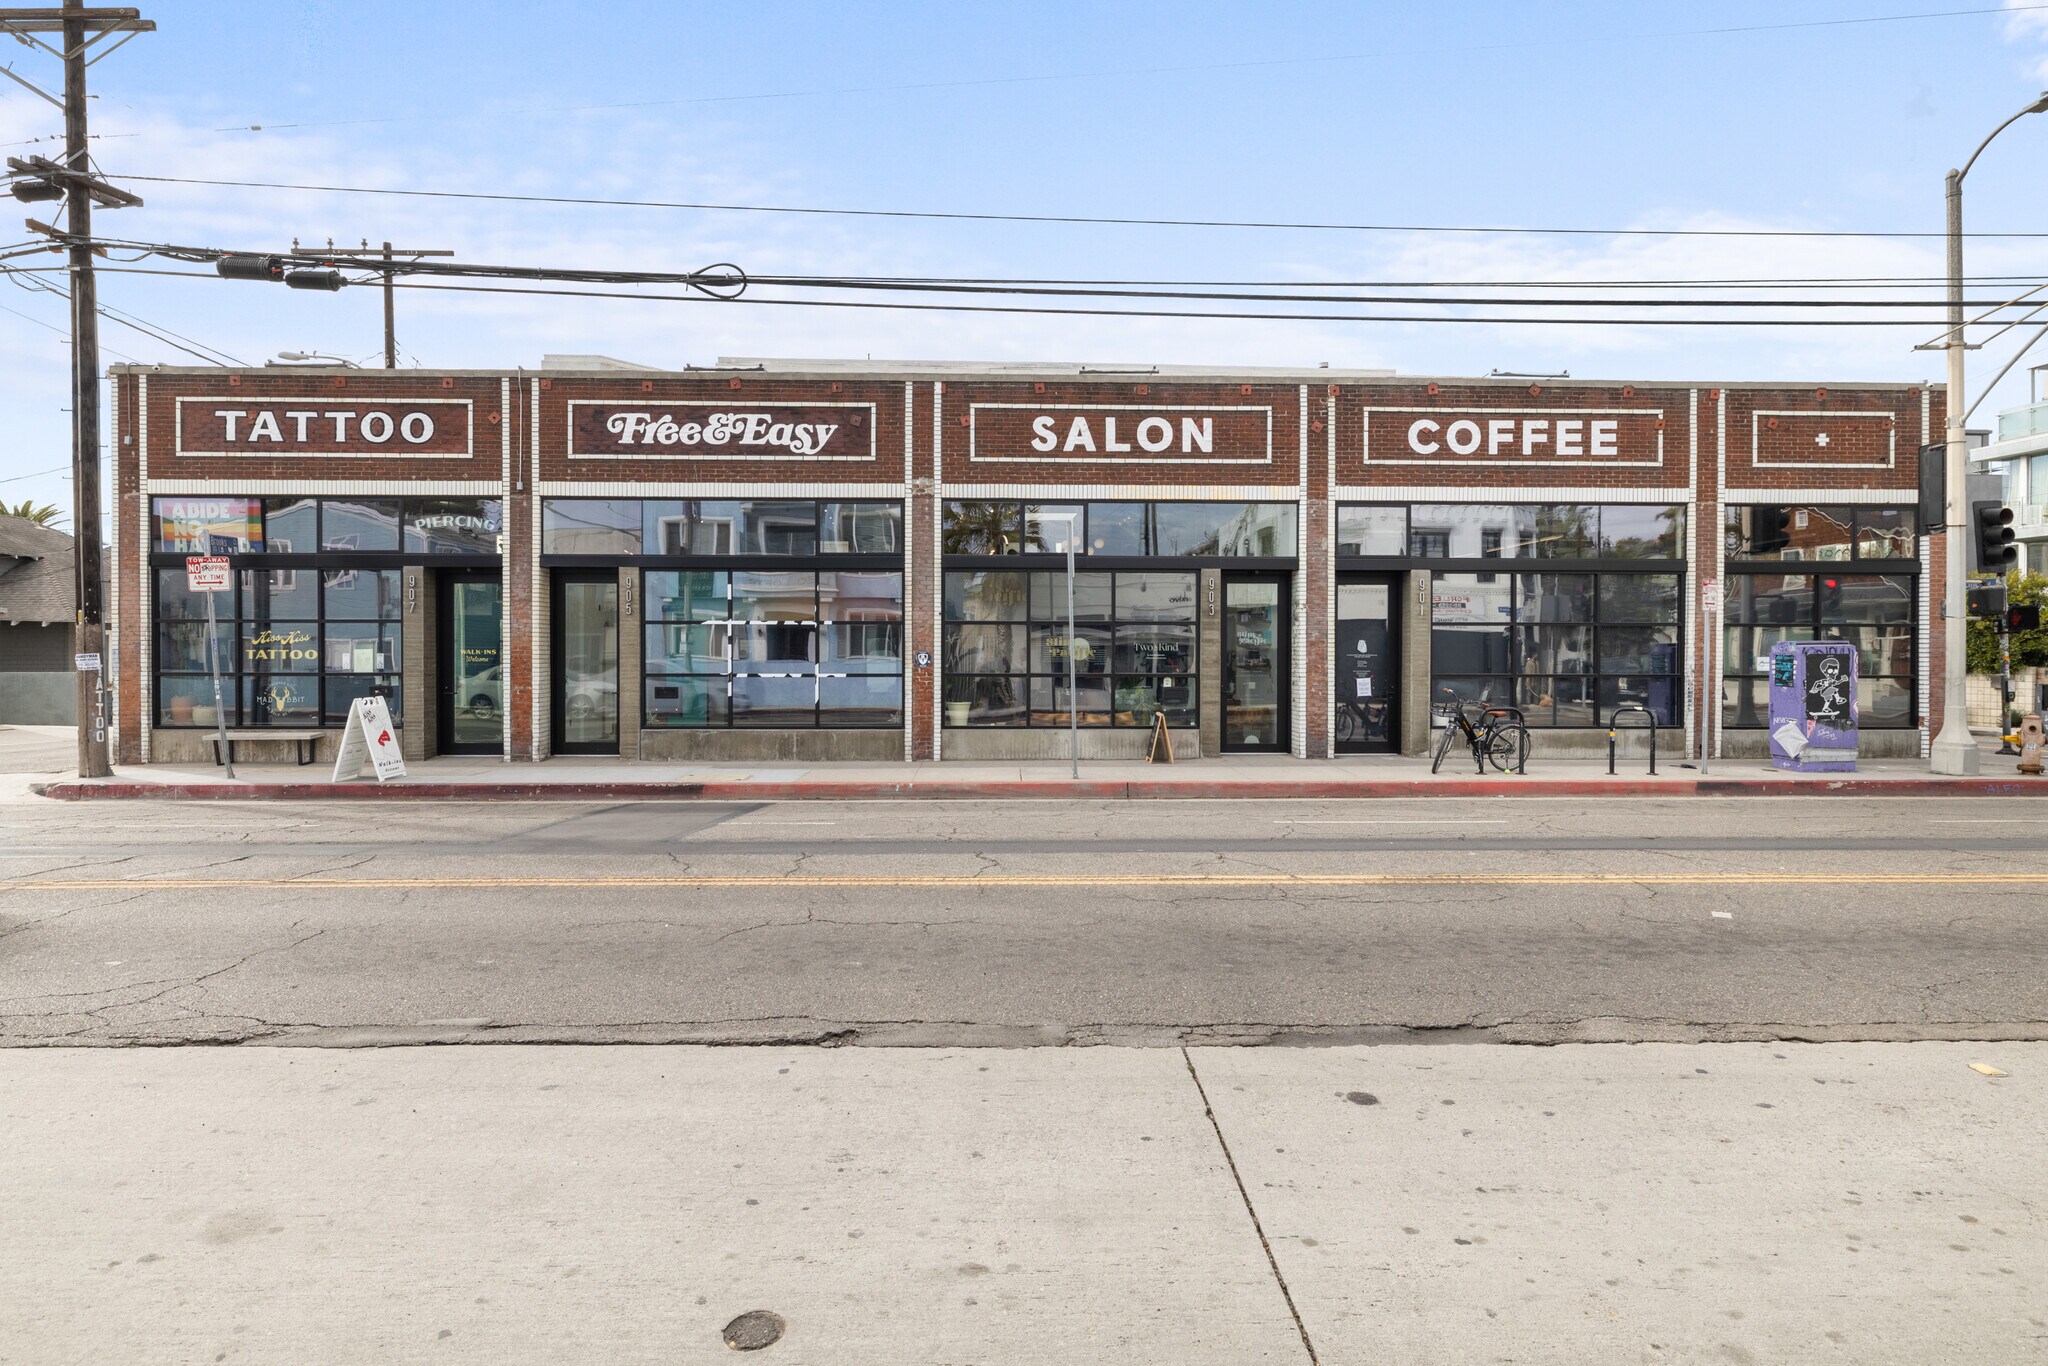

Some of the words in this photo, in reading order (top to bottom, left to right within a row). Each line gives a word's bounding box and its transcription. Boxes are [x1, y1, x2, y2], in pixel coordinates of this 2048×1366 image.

[213, 410, 435, 444] TATTOO
[1030, 415, 1213, 453] SALON
[1407, 419, 1618, 456] COFFEE
[172, 503, 230, 518] ABIDE
[414, 515, 496, 531] PIERCING
[188, 563, 200, 573] NO
[408, 575, 416, 614] 907
[624, 576, 632, 615] 905
[252, 630, 281, 645] Kiss
[281, 630, 312, 645] Kiss
[460, 648, 497, 656] WALK-INS
[1134, 641, 1154, 652] Two
[1158, 641, 1179, 652] Kind
[246, 649, 318, 660] TATTOO
